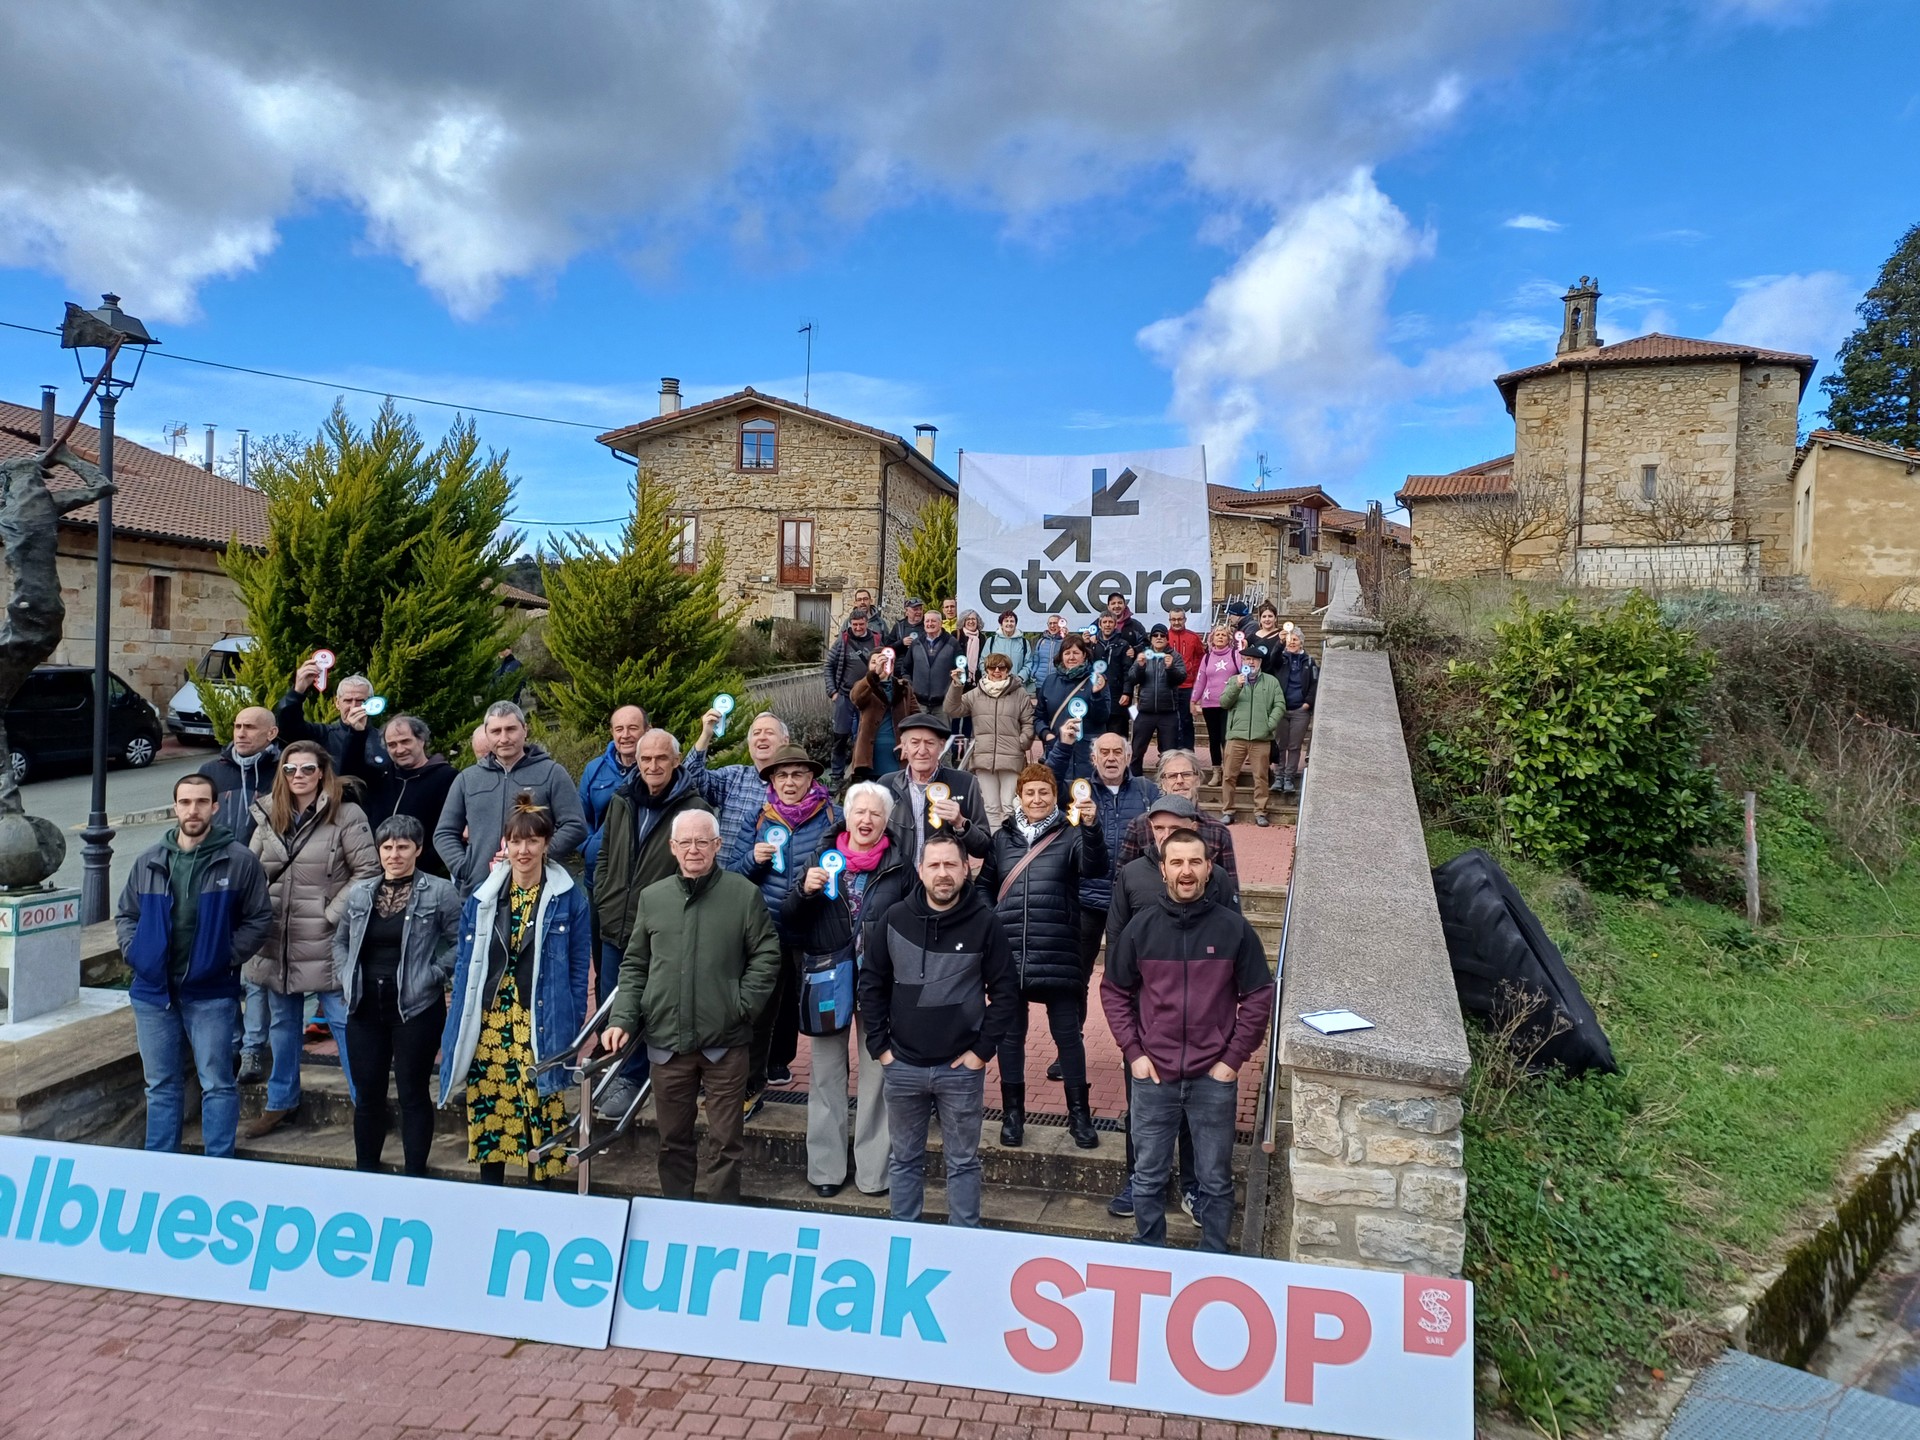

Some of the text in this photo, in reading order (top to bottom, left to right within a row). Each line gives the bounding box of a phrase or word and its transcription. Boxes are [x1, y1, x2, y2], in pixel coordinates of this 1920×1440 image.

[979, 559, 1203, 615] etxera
[23, 903, 73, 926] 200 K
[487, 1228, 950, 1344] neurriak
[1004, 1257, 1372, 1406] STOP
